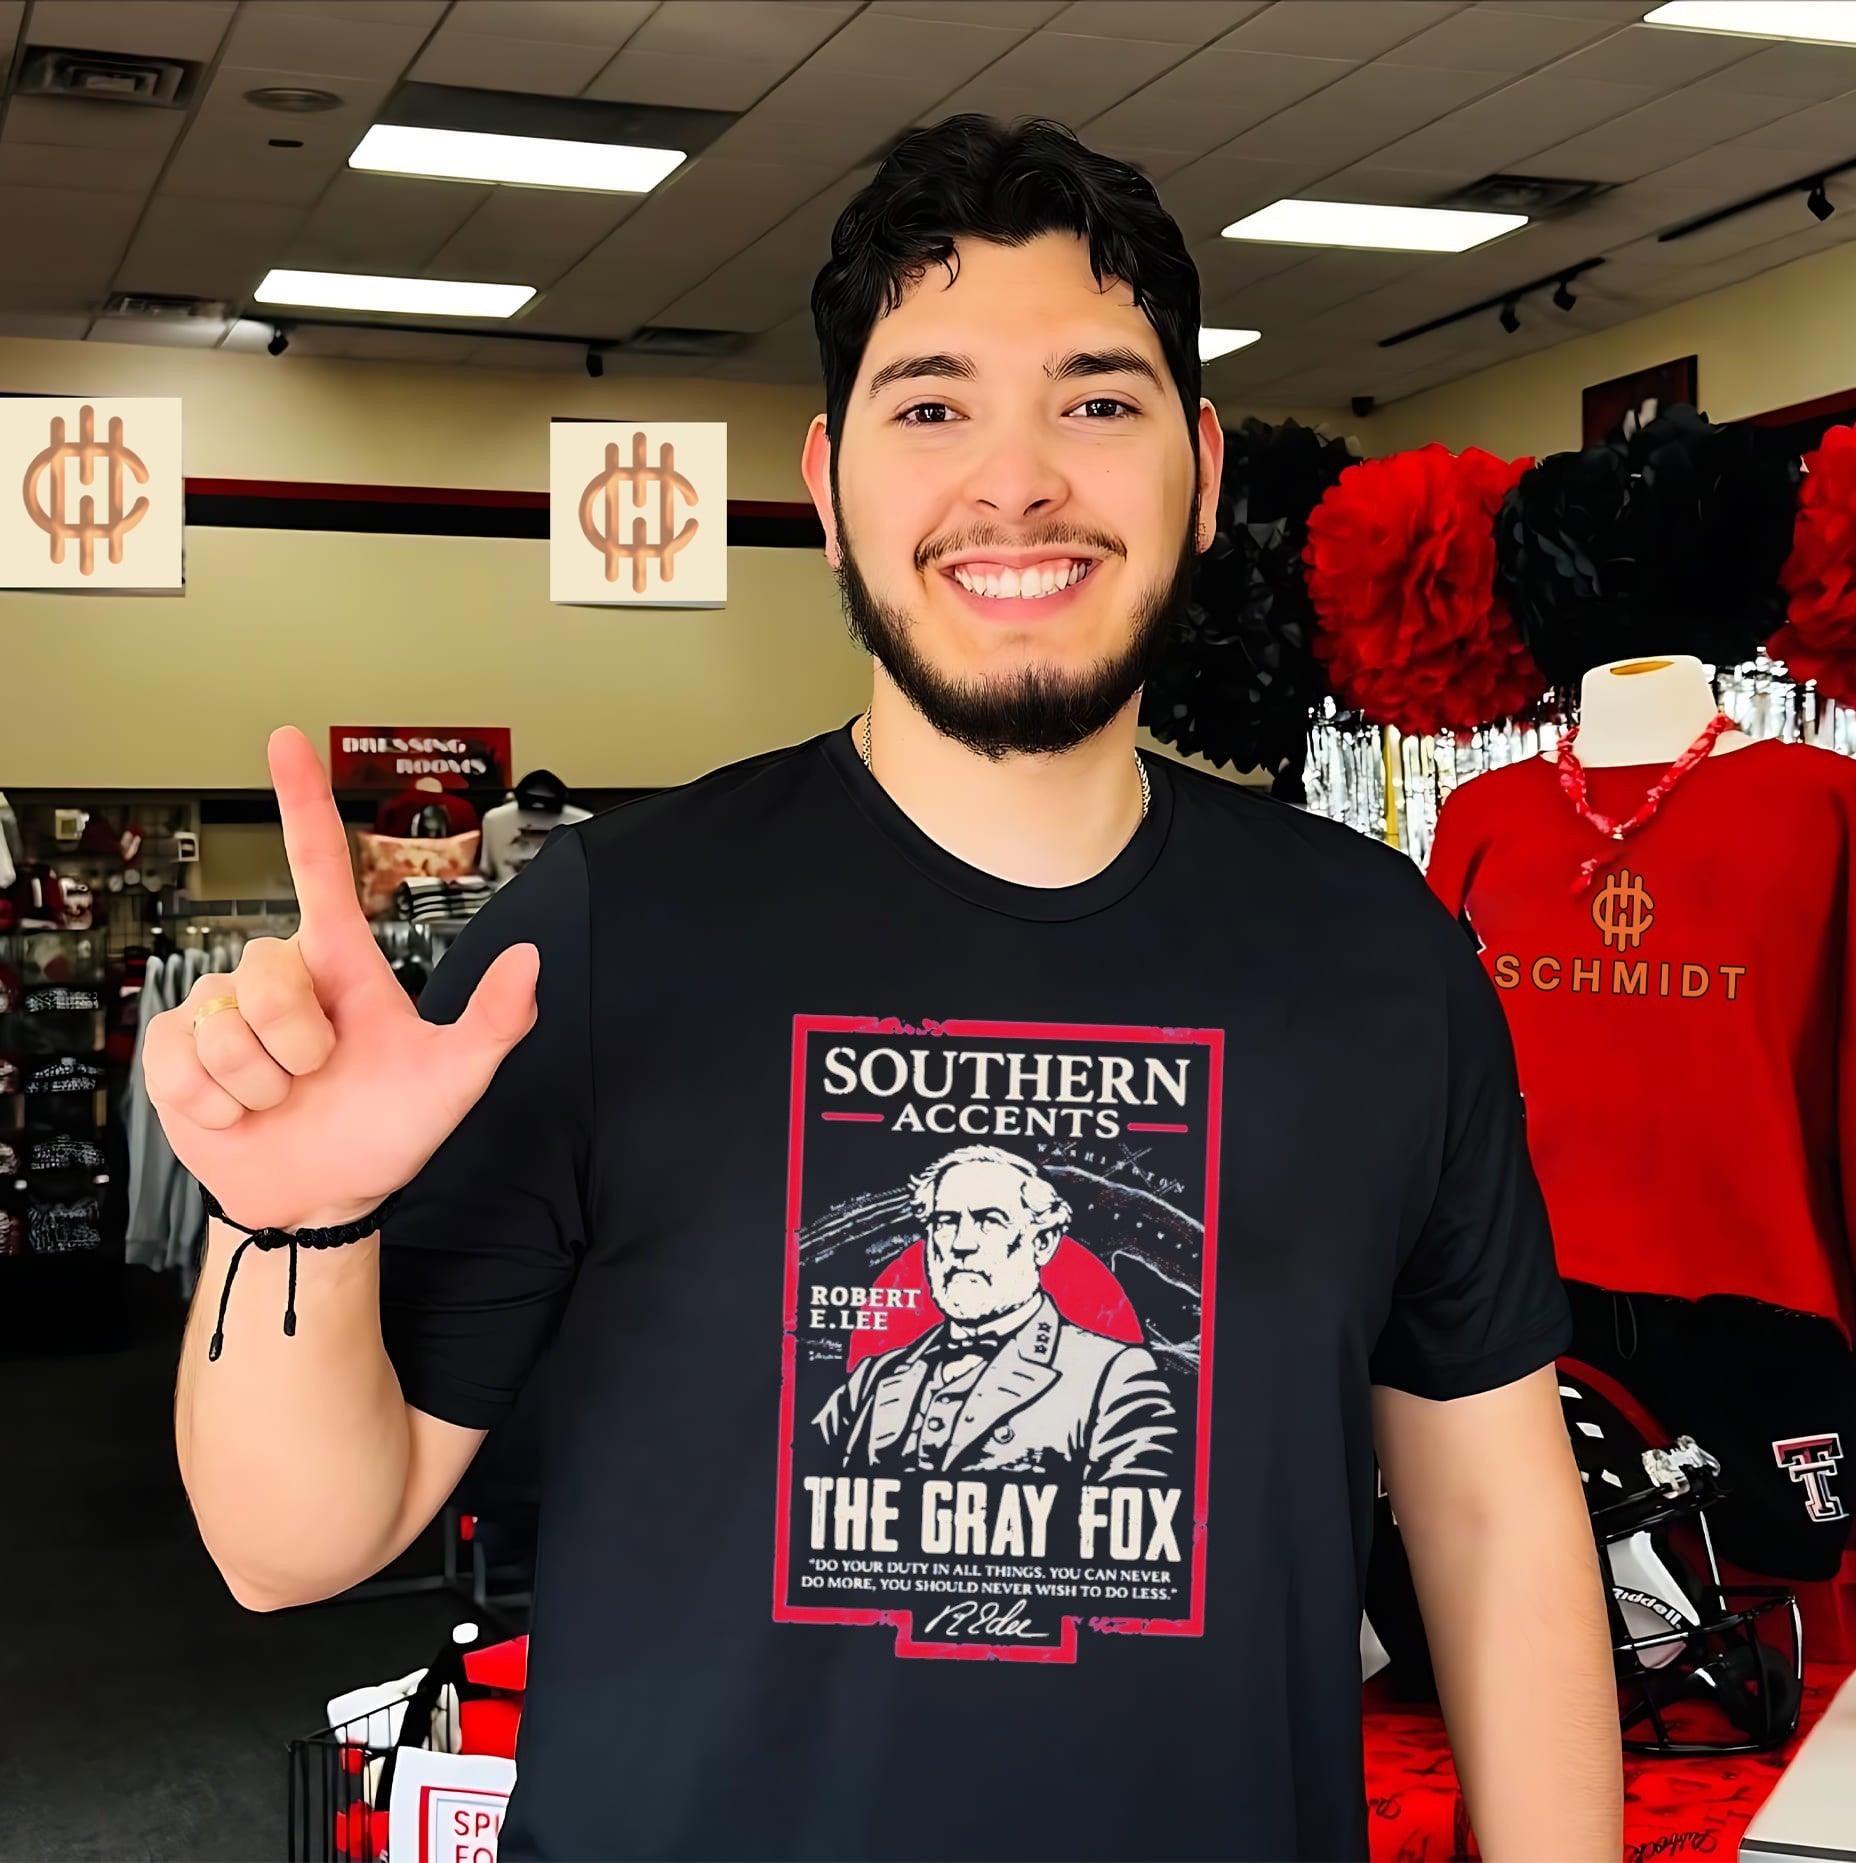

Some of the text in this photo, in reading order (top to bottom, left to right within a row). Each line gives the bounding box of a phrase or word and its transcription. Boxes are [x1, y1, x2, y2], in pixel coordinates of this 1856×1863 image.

[342, 737, 467, 753] DRESSING
[396, 758, 487, 775] ROOMS
[1494, 954, 1747, 1000] SCHMIDT
[823, 1046, 1191, 1106] SOUTHERN
[891, 1102, 1120, 1139] ACCENTS
[810, 1285, 921, 1308] ROBERT
[803, 1476, 1182, 1562] THE GRAY FOX
[842, 1560, 883, 1573] YOUR
[887, 1562, 929, 1575] DUTY
[933, 1563, 950, 1575] IN
[953, 1564, 981, 1577] ALL
[985, 1565, 1046, 1579] THINGS.
[1050, 1568, 1080, 1580] YOU
[1084, 1568, 1117, 1581] CAN
[1120, 1570, 1171, 1583] NEVER
[801, 1576, 824, 1588] DO
[827, 1577, 877, 1592] MORE,
[880, 1578, 911, 1591] YOU
[915, 1580, 979, 1594] SHOULD
[981, 1582, 1032, 1595] NEVER
[1035, 1584, 1077, 1597] WISH
[1080, 1585, 1102, 1598] TO
[1105, 1587, 1128, 1599] DO
